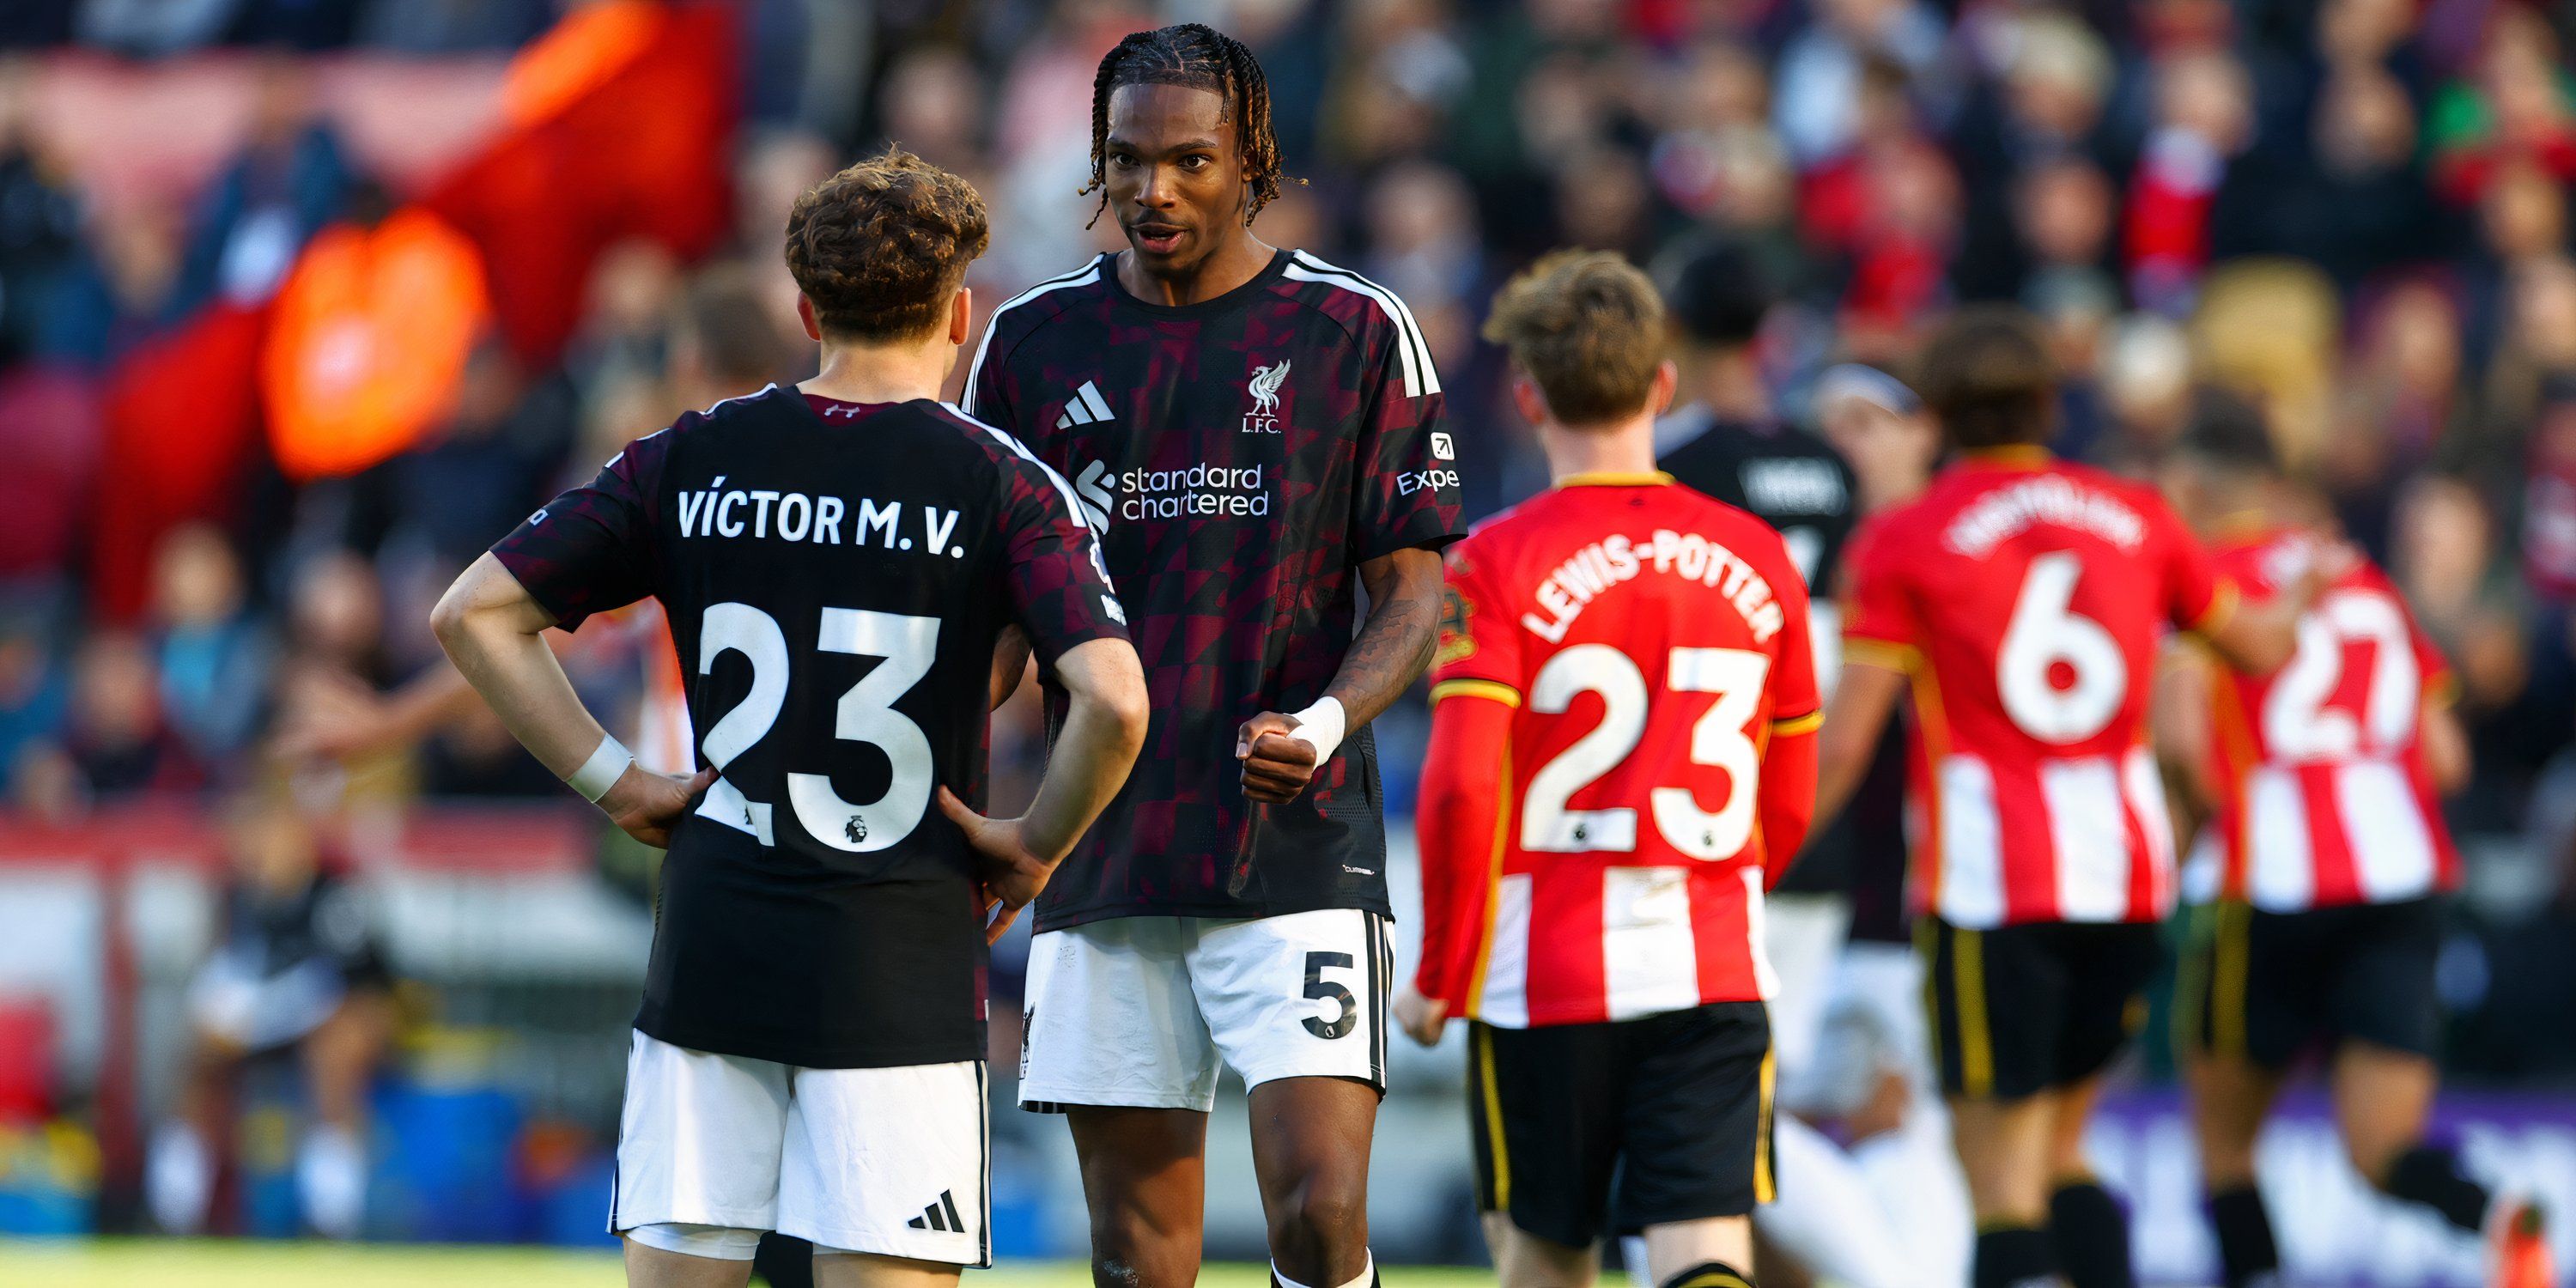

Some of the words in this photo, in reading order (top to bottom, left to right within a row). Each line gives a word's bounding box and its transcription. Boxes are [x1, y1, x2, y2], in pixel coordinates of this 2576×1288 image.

[1242, 417, 1281, 434] L.F.C.
[678, 476, 841, 544] VÍCTOR
[856, 498, 913, 550] M.
[925, 507, 964, 559] V.
[1121, 462, 1261, 493] standard
[1121, 489, 1269, 520] chartered
[1521, 529, 1785, 645] LEWIS-POTTER
[1996, 549, 2129, 746] 6
[2262, 587, 2418, 762] 27
[695, 601, 941, 853] 23
[1519, 642, 1772, 862] 23
[1301, 951, 1357, 1040] 5
